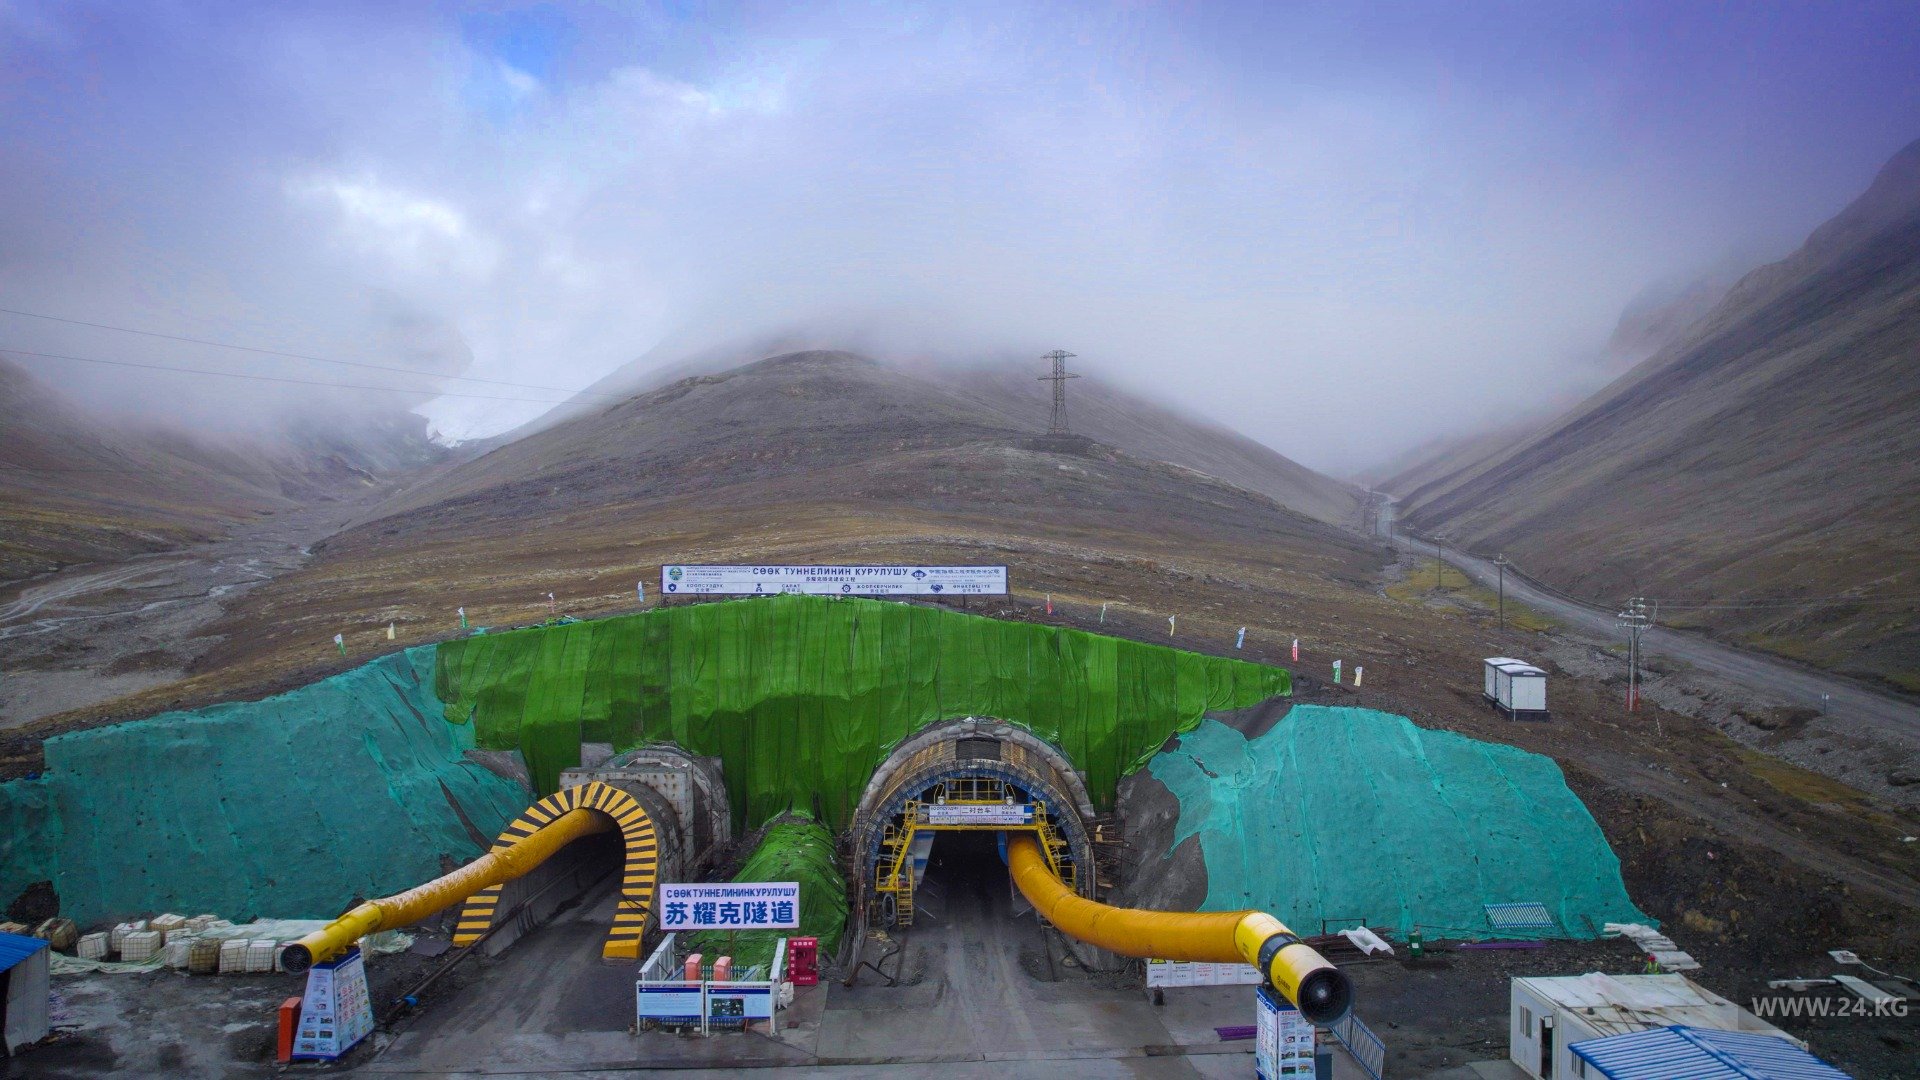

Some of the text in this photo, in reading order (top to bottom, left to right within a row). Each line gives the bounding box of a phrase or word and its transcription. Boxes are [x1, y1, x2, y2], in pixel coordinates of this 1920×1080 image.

[752, 567, 780, 575] СӨӨК
[784, 567, 851, 576] ТУННЕЛИНИН
[855, 568, 908, 576] КУРУЛУШУ
[665, 900, 795, 926] 苏耀克隧道
